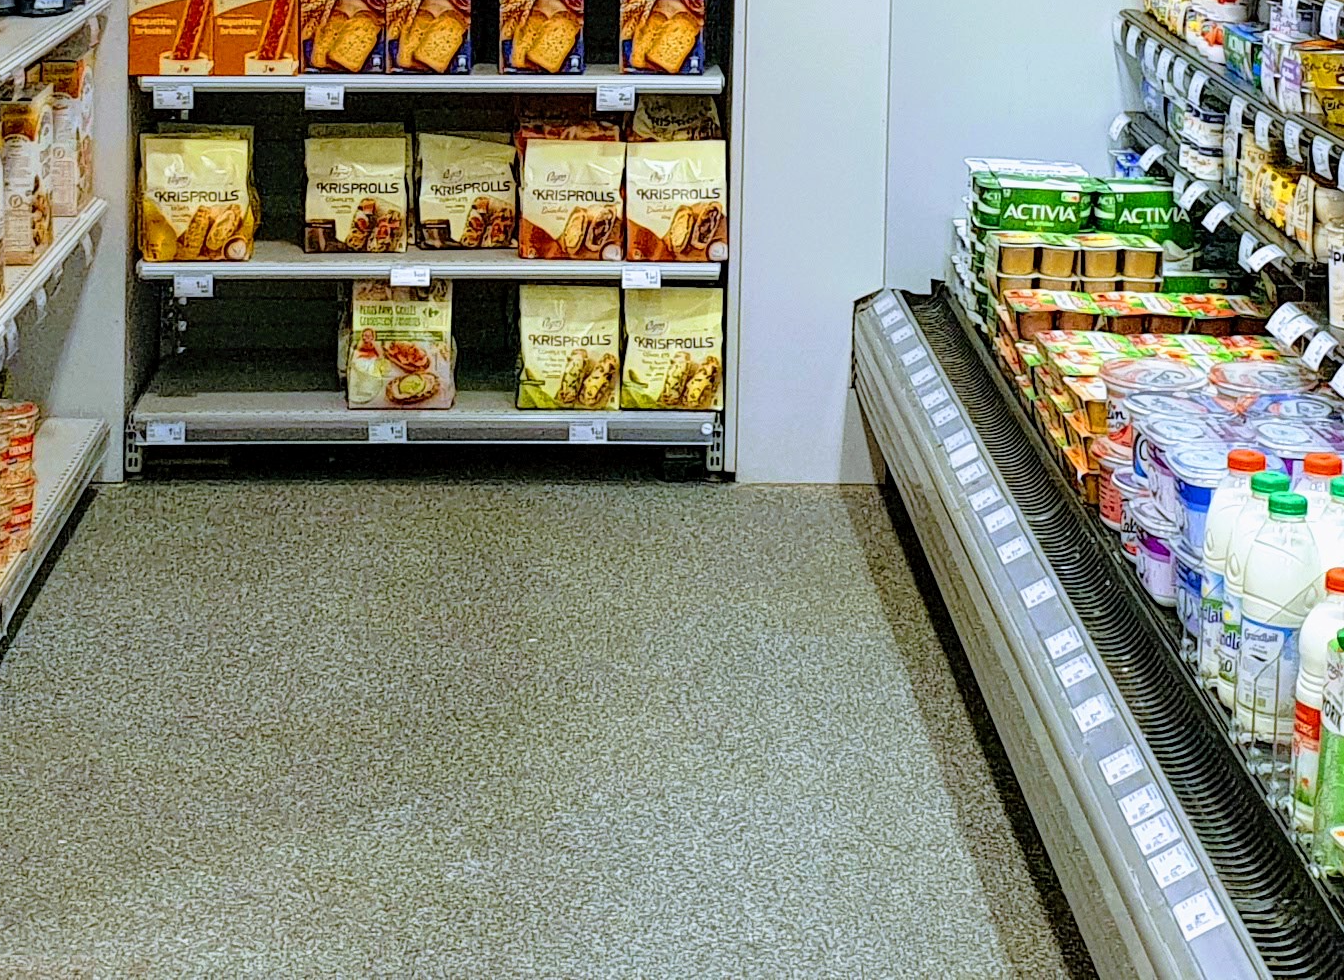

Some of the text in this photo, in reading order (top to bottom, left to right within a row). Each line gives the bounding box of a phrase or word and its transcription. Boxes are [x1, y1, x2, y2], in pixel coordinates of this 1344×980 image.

[316, 181, 399, 195] KRISPROLLS
[430, 180, 511, 196] KRISPROLLS
[532, 188, 616, 203] KRISPROLLS
[636, 187, 721, 201] KRISPROLLS
[154, 189, 239, 204] KRISPROLLS
[1004, 203, 1077, 222] ACTIVIA
[1118, 205, 1190, 224] ACTIVIA
[528, 334, 612, 347] KRISPROLLS
[633, 335, 715, 350] KRISPROLLS
